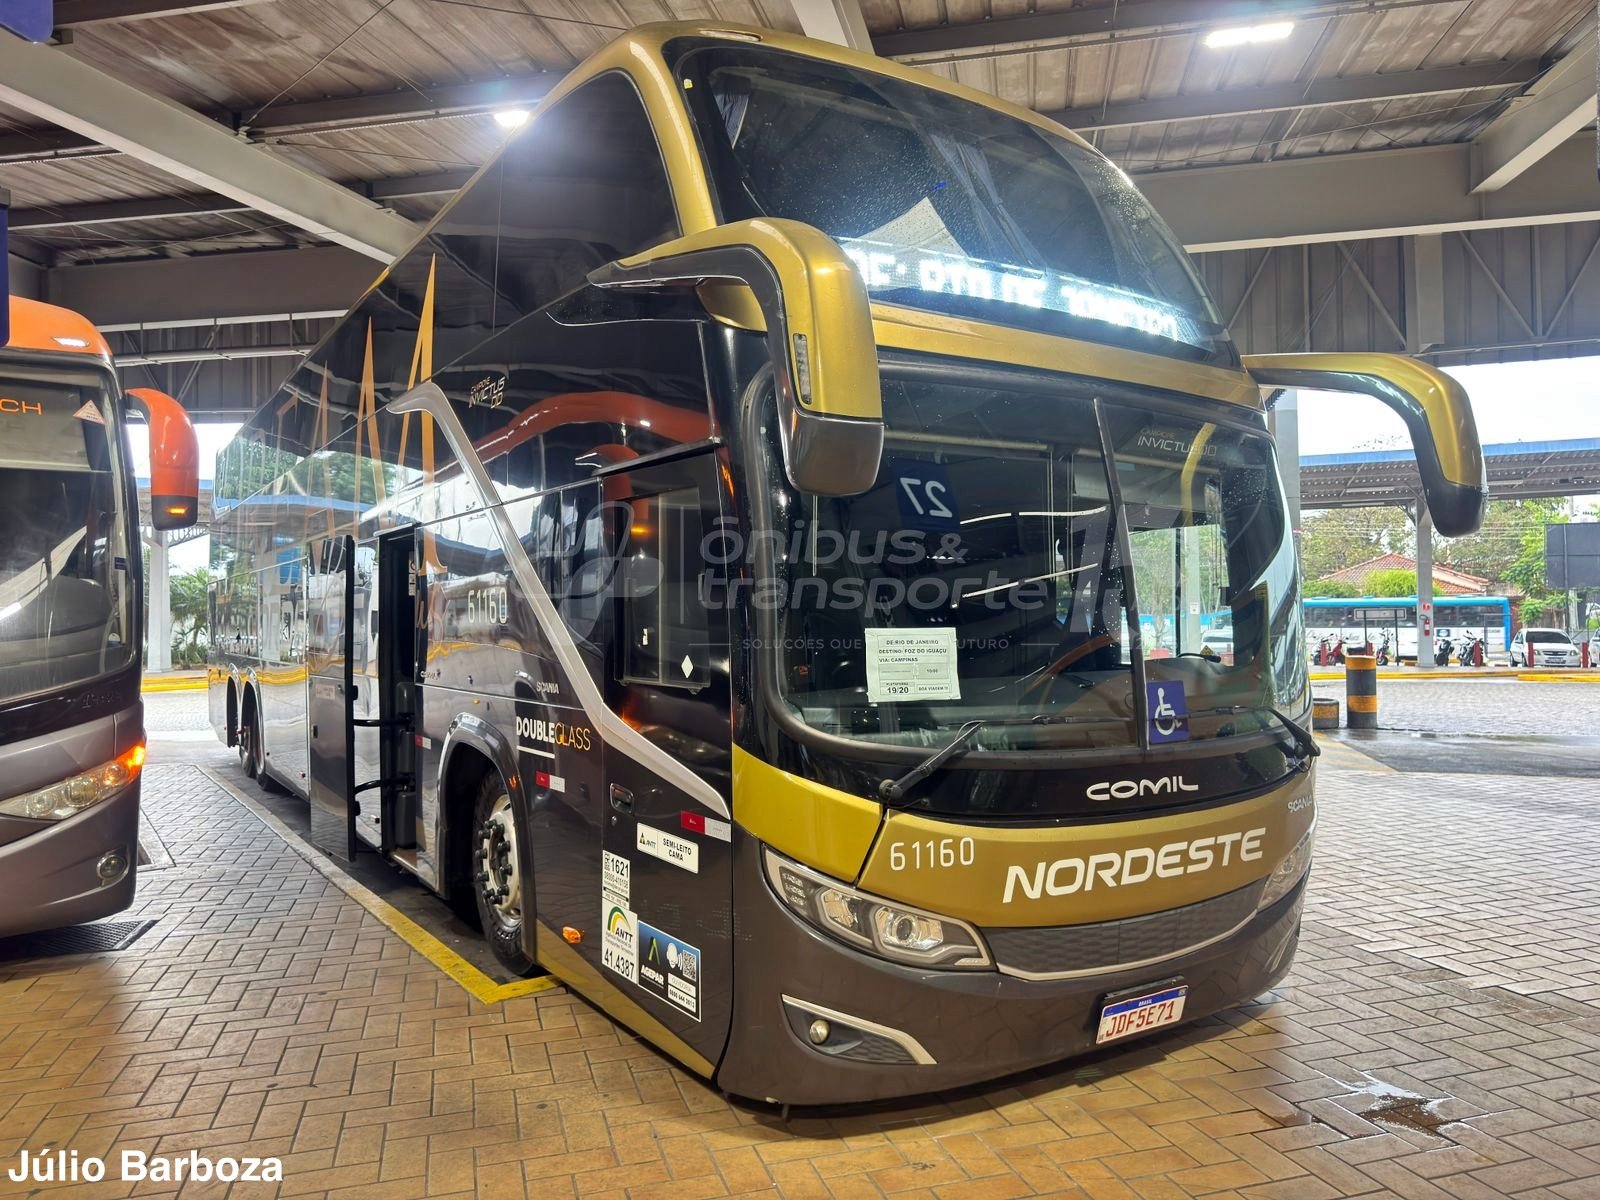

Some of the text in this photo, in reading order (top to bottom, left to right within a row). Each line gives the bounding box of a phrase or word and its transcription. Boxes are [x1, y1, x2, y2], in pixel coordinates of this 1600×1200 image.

[468, 587, 507, 624] 61160
[536, 681, 560, 694] SCANIA
[1086, 775, 1199, 801] COMIL
[663, 838, 692, 856] SEMI-LEITO
[669, 850, 684, 862] CAMA
[890, 837, 975, 871] 61160
[611, 857, 629, 879] 1621
[1002, 827, 1267, 904] NORDESTE
[615, 927, 633, 943] ANTT
[604, 947, 635, 980] 41.4387
[1106, 1001, 1174, 1038] JDF5E71
